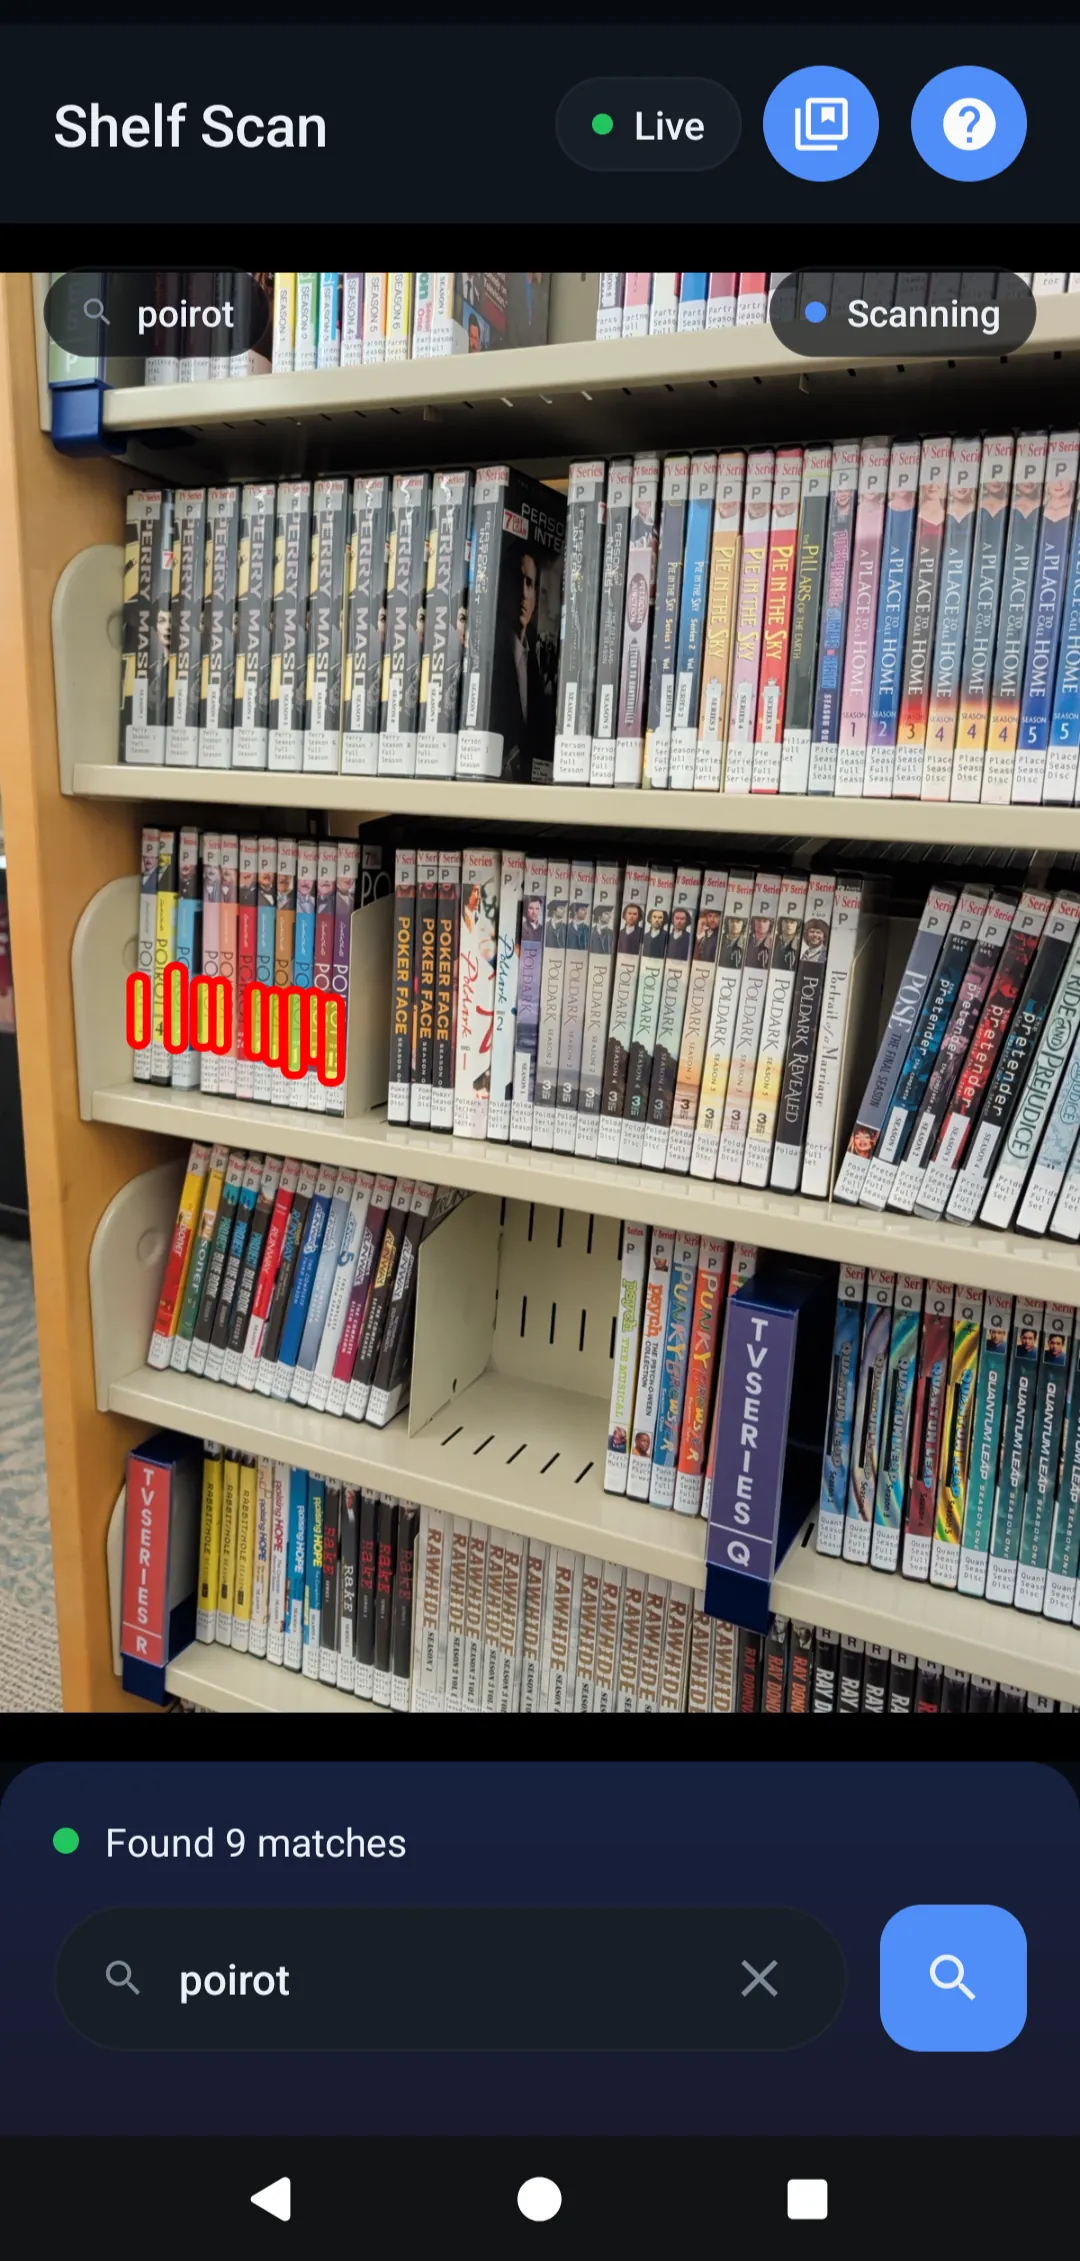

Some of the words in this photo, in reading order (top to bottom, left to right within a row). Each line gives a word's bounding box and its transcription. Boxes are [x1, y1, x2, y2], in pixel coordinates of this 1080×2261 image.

[371, 277, 379, 321] SEASON
[575, 486, 585, 498] P
[780, 486, 790, 499] P
[930, 466, 941, 480] P
[857, 560, 874, 614] PLACE
[887, 557, 904, 613] PLACE
[978, 554, 997, 610] PLACE
[1041, 554, 1060, 611] PLACE
[137, 611, 150, 679] MAS
[178, 611, 190, 680] MAS
[854, 617, 862, 638] CALL
[862, 617, 869, 629] TO
[884, 615, 892, 636] CALL
[891, 615, 899, 628] TO
[849, 640, 868, 696] HOME
[879, 638, 898, 695] HOME
[968, 637, 988, 695] HOME
[1029, 639, 1050, 698] HOME
[850, 722, 856, 737] 1
[873, 710, 896, 718] SEASON
[879, 722, 888, 737] 2
[967, 723, 977, 739] 4
[1029, 727, 1038, 743] 5
[814, 899, 823, 910] P
[397, 917, 411, 984] POKER
[421, 918, 435, 985] POKER
[438, 919, 452, 986] POKER
[520, 947, 538, 1014] POLDARK
[543, 959, 563, 1023] POLDARK
[587, 963, 607, 1030] POLDARK
[609, 963, 636, 1033] POLDARK
[888, 971, 927, 1033] POSE
[395, 987, 408, 1035] FACE
[420, 989, 432, 1039] FACE
[437, 991, 450, 1041] FACE
[709, 976, 737, 1048] POLDARK
[763, 978, 791, 1051] POLDARK
[792, 975, 819, 1050] POLDARK
[921, 978, 949, 1056] pretender
[946, 982, 976, 1061] pretender
[960, 1004, 1003, 1109] pretender
[994, 1010, 1036, 1118] pretender
[785, 1051, 808, 1123] REVEALED
[693, 1272, 718, 1369] PUNKY
[933, 1300, 945, 1314] Q
[1022, 1313, 1034, 1328] Q
[983, 1370, 998, 1441] QUANTUM
[1042, 1382, 1057, 1454] QUANTUM
[980, 1441, 991, 1481] LEAP
[1037, 1454, 1048, 1494] LEAP
[274, 1519, 284, 1553] HOPE
[294, 1540, 305, 1574] HOPE
[313, 1535, 323, 1568] HOPE
[726, 1540, 751, 1567] Q
[423, 1528, 442, 1629] RAWHIDE
[449, 1533, 467, 1634] RAWHIDE
[467, 1537, 485, 1640] RAWHIDE
[523, 1556, 543, 1661] RAWHIDE
[550, 1565, 572, 1673] RAWHIDE
[596, 1581, 620, 1691] RAWHIDE
[822, 1629, 831, 1639] R
[135, 1636, 148, 1655] R
[661, 1600, 686, 1710] RAWHIDE
[767, 1655, 784, 1679] RAY
[793, 1656, 807, 1679] RAY
[815, 1667, 834, 1698] RAY
[841, 1676, 860, 1707] RAY
